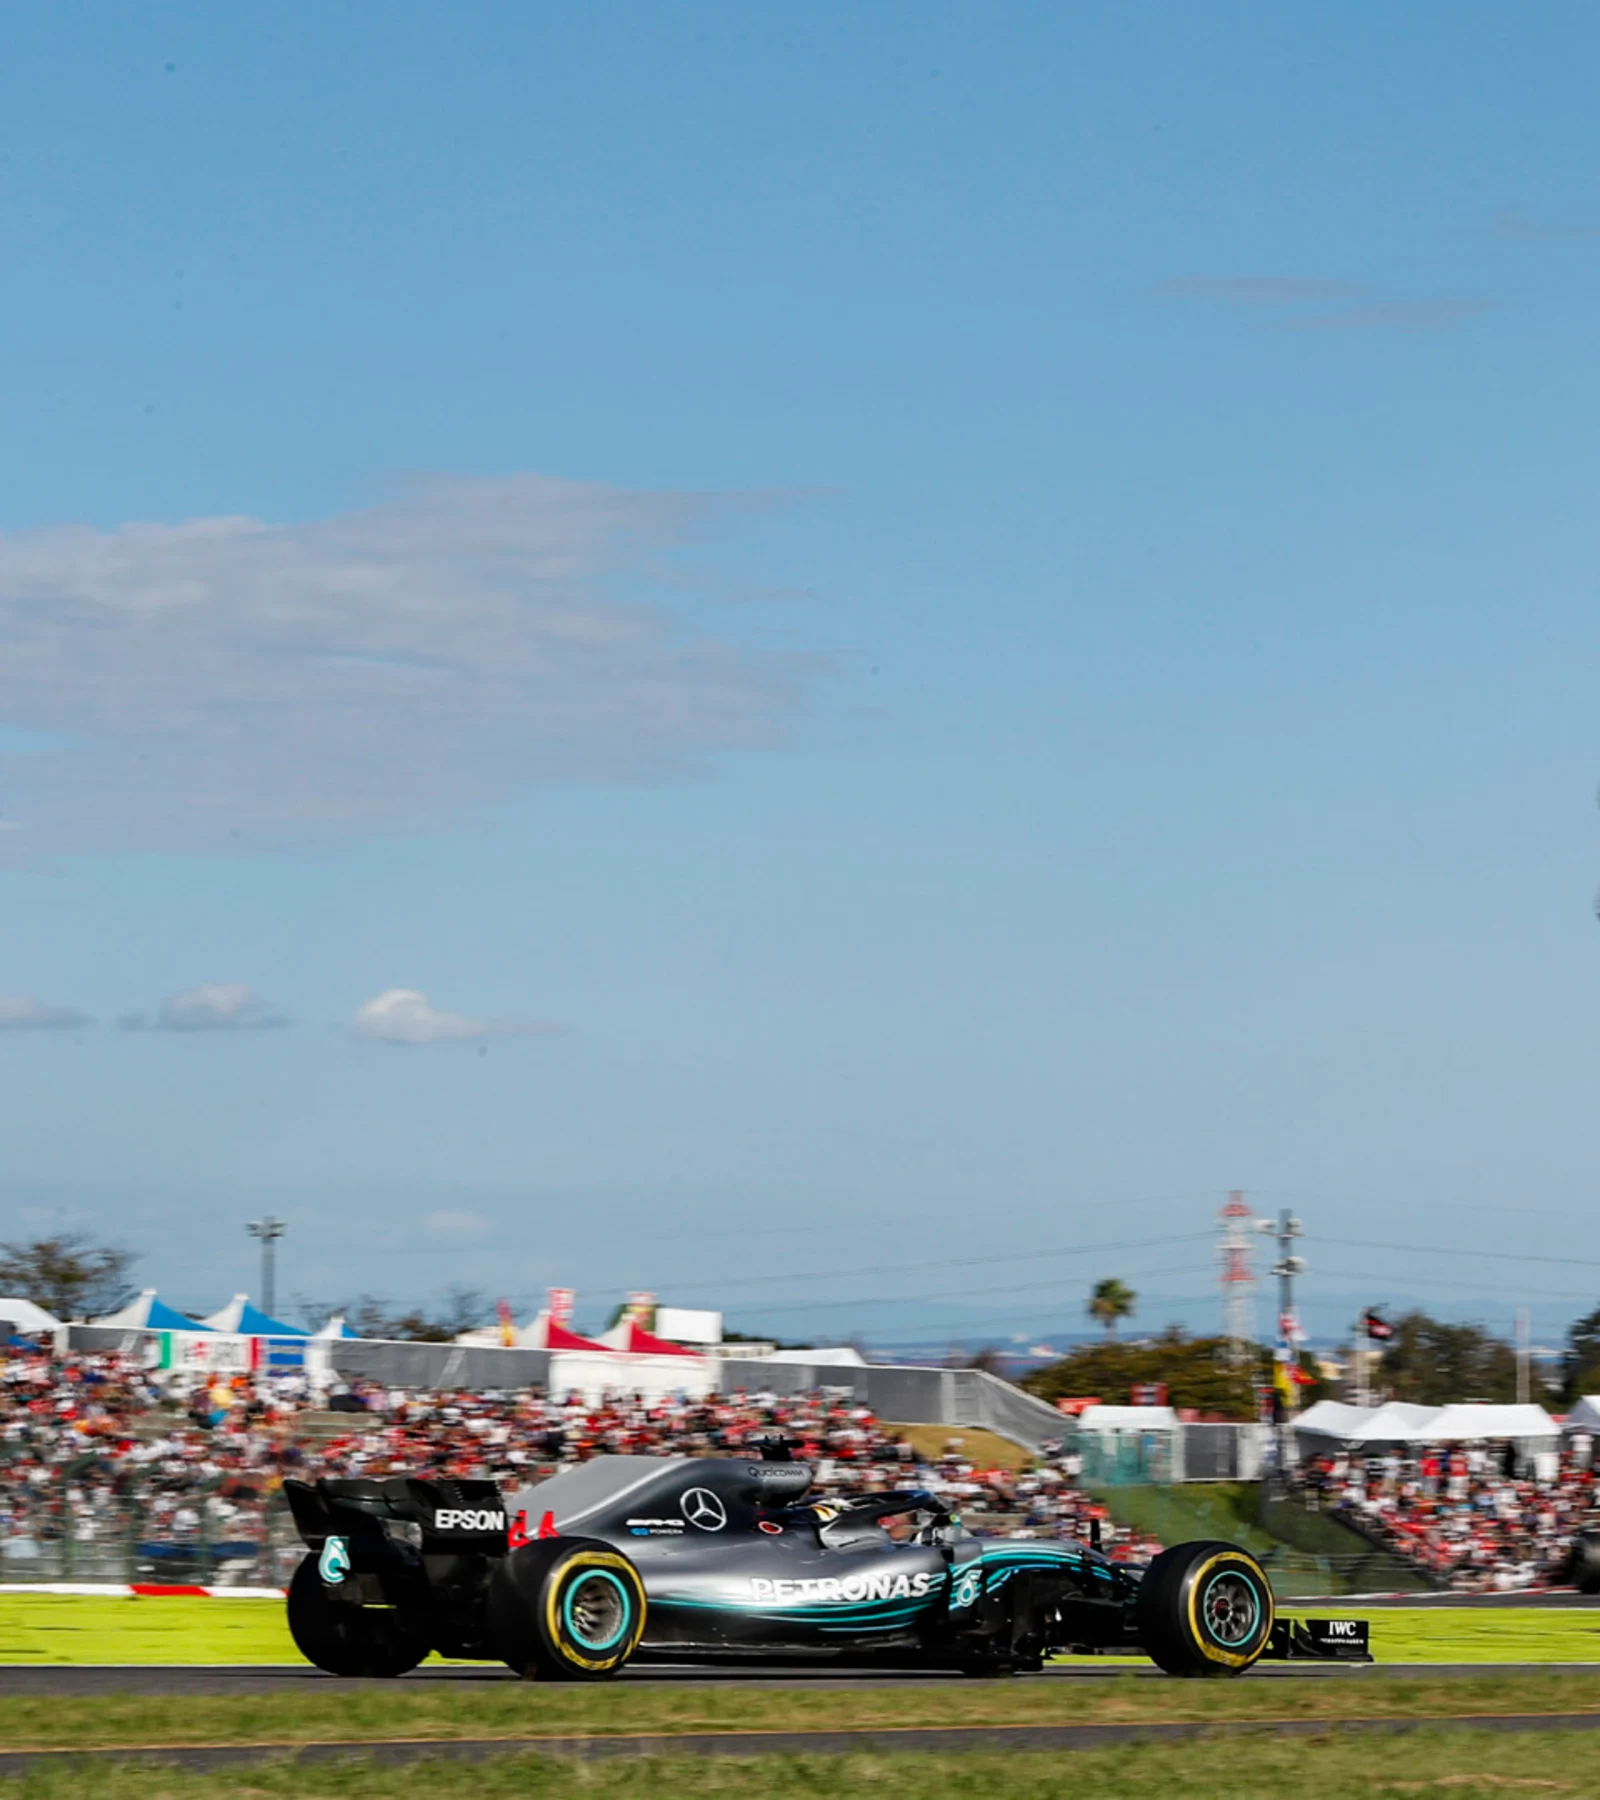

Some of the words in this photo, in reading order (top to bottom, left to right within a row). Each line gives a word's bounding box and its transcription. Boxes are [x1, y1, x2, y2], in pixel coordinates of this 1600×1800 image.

[435, 1508, 505, 1531] EPSON
[750, 1573, 931, 1601] PETRONAS
[1328, 1621, 1356, 1636] IWC
